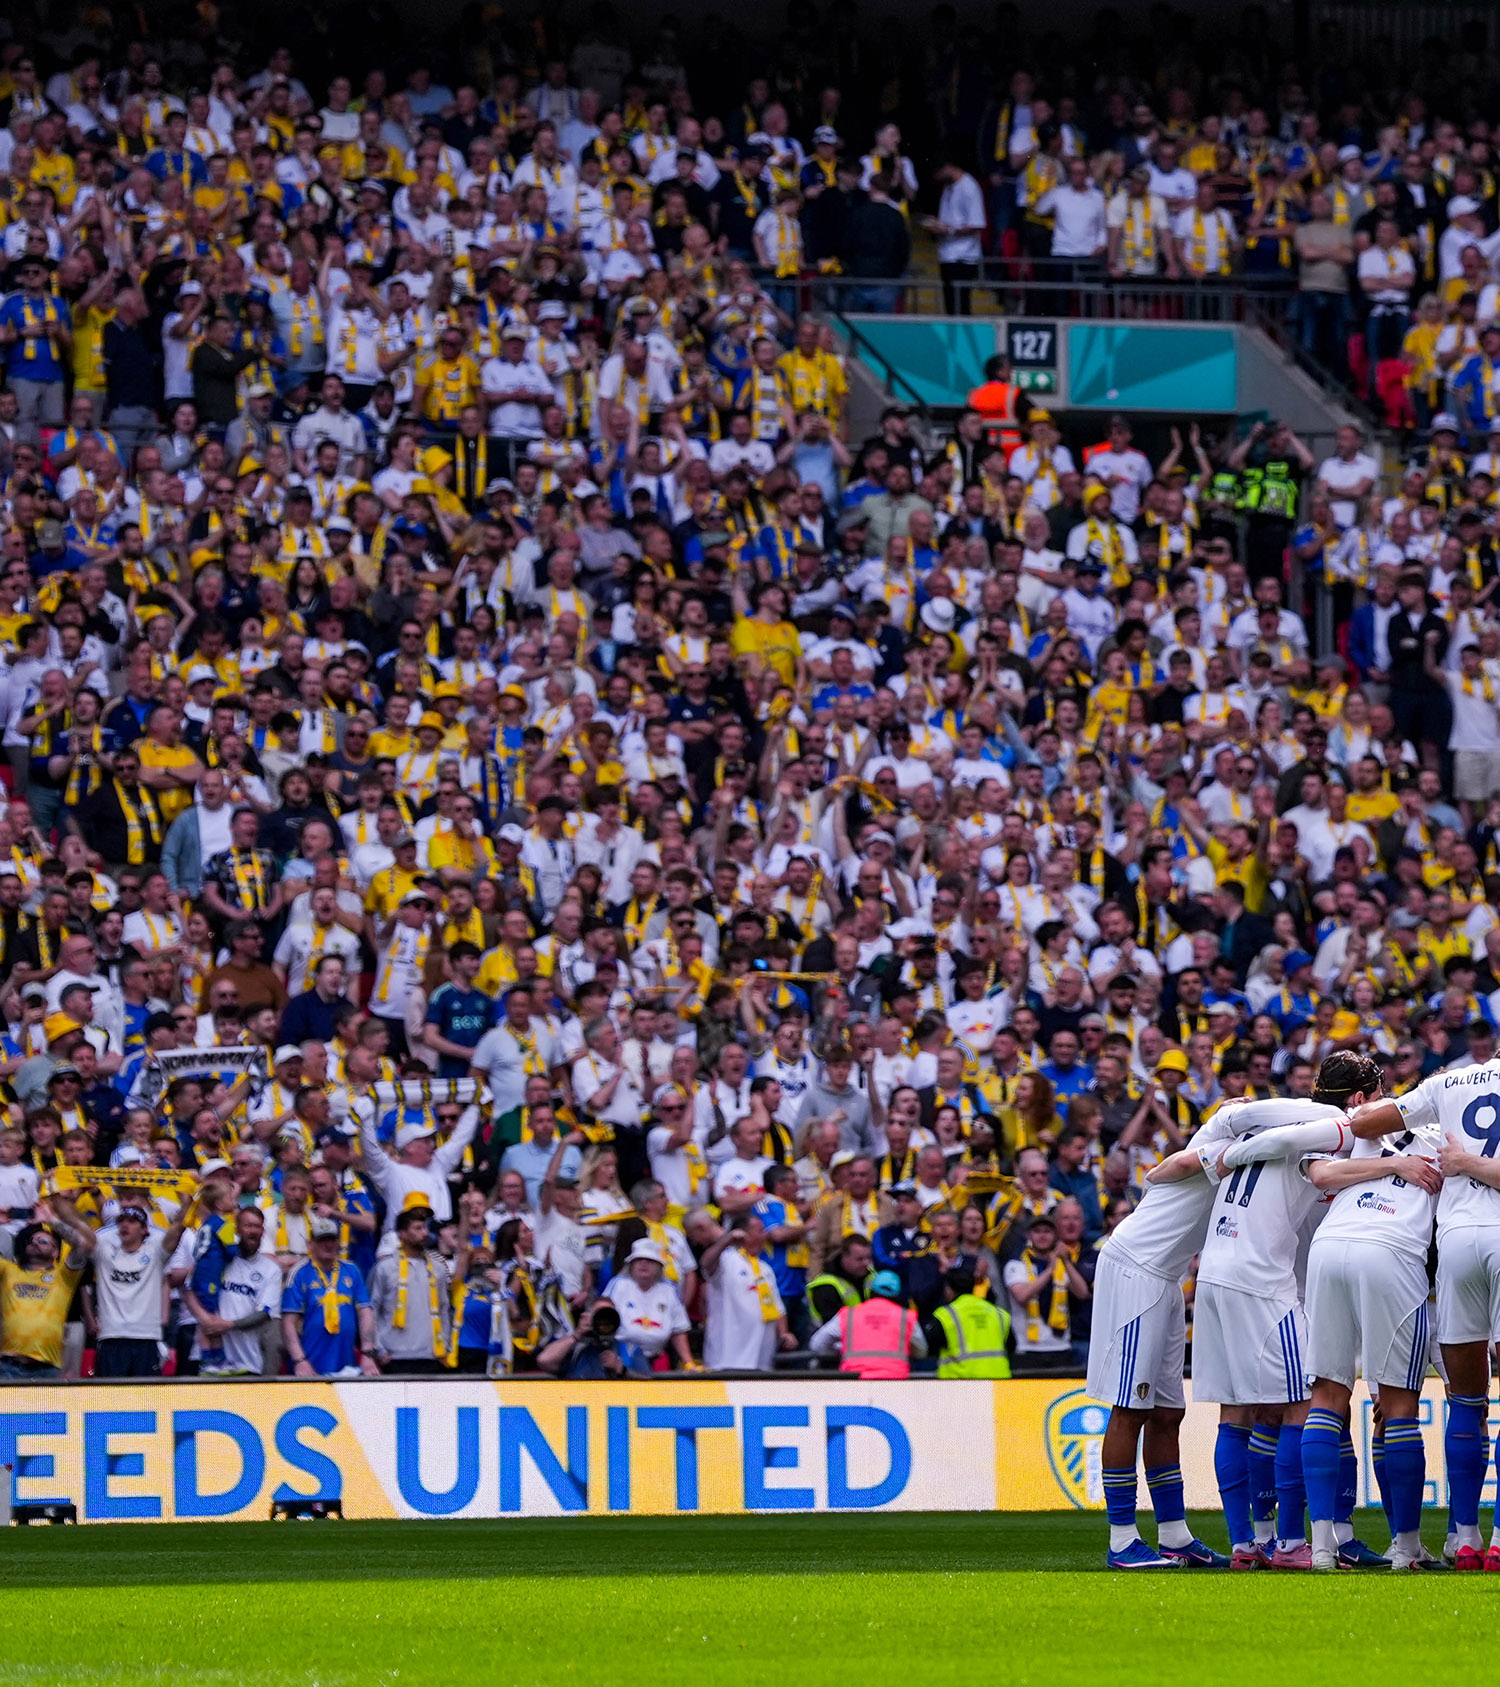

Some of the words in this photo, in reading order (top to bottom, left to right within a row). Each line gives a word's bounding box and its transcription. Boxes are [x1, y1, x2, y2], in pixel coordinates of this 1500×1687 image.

[1012, 331, 1052, 360] 127
[1225, 1133, 1266, 1208] 11
[396, 1405, 913, 1515] UNITED
